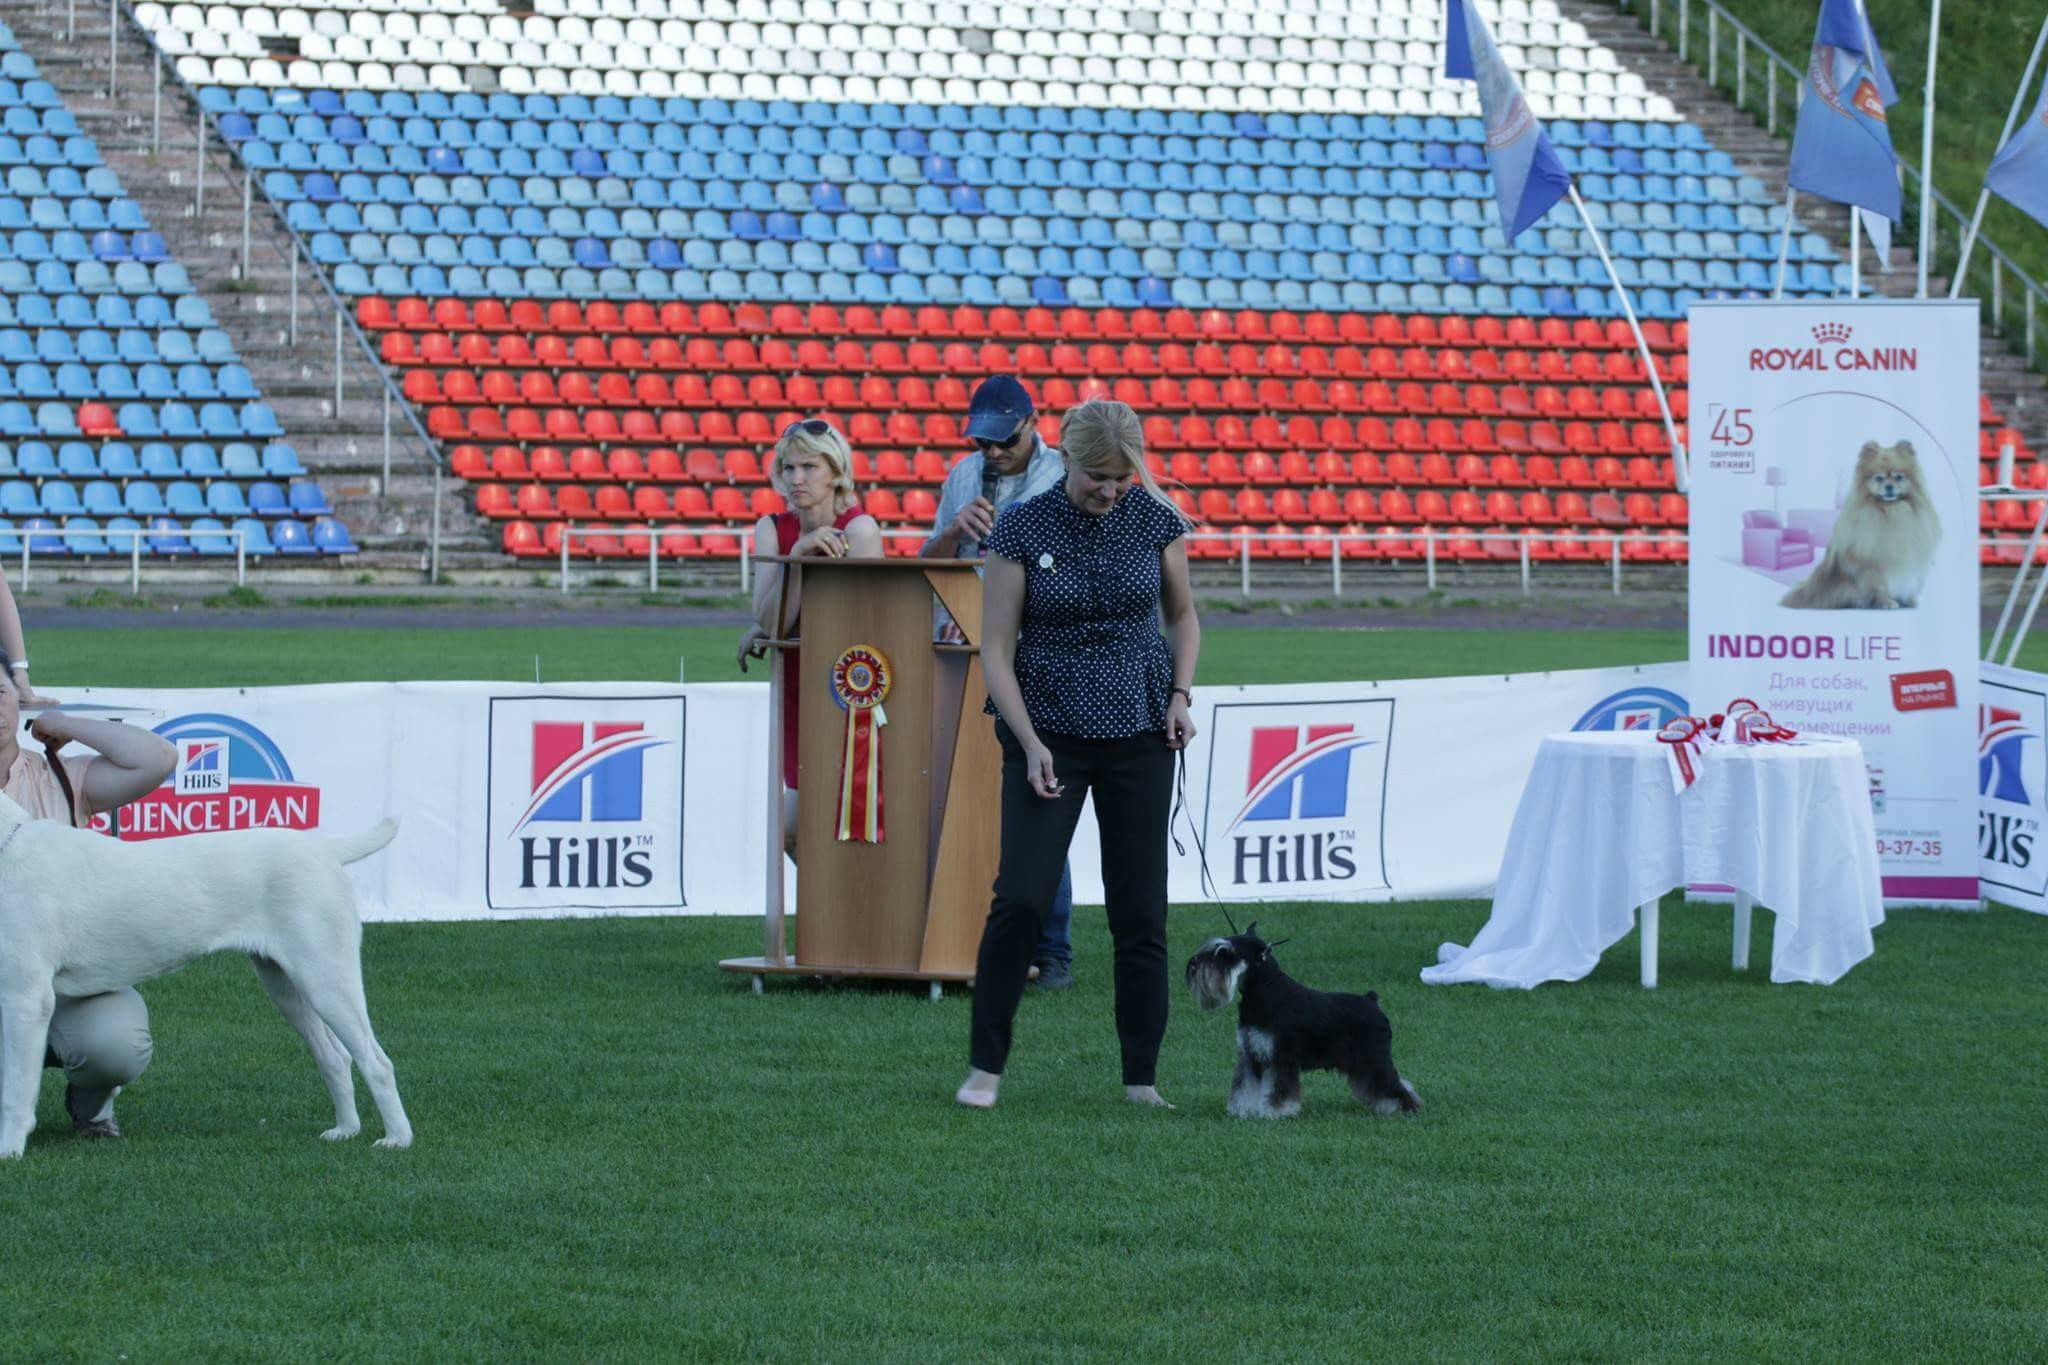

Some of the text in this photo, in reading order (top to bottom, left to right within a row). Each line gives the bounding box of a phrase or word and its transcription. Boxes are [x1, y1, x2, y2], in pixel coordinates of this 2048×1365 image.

[1750, 348, 1917, 371] ROYAL CANIN
[1711, 408, 1753, 446] 45
[1708, 634, 1901, 661] INDOOR LIFE
[1769, 672, 1806, 692] Для
[1769, 700, 1854, 716] живущих
[184, 774, 221, 789] Hill's
[228, 795, 308, 829] PLAN
[518, 836, 653, 888] Hill's
[1232, 831, 1357, 885] Hill's
